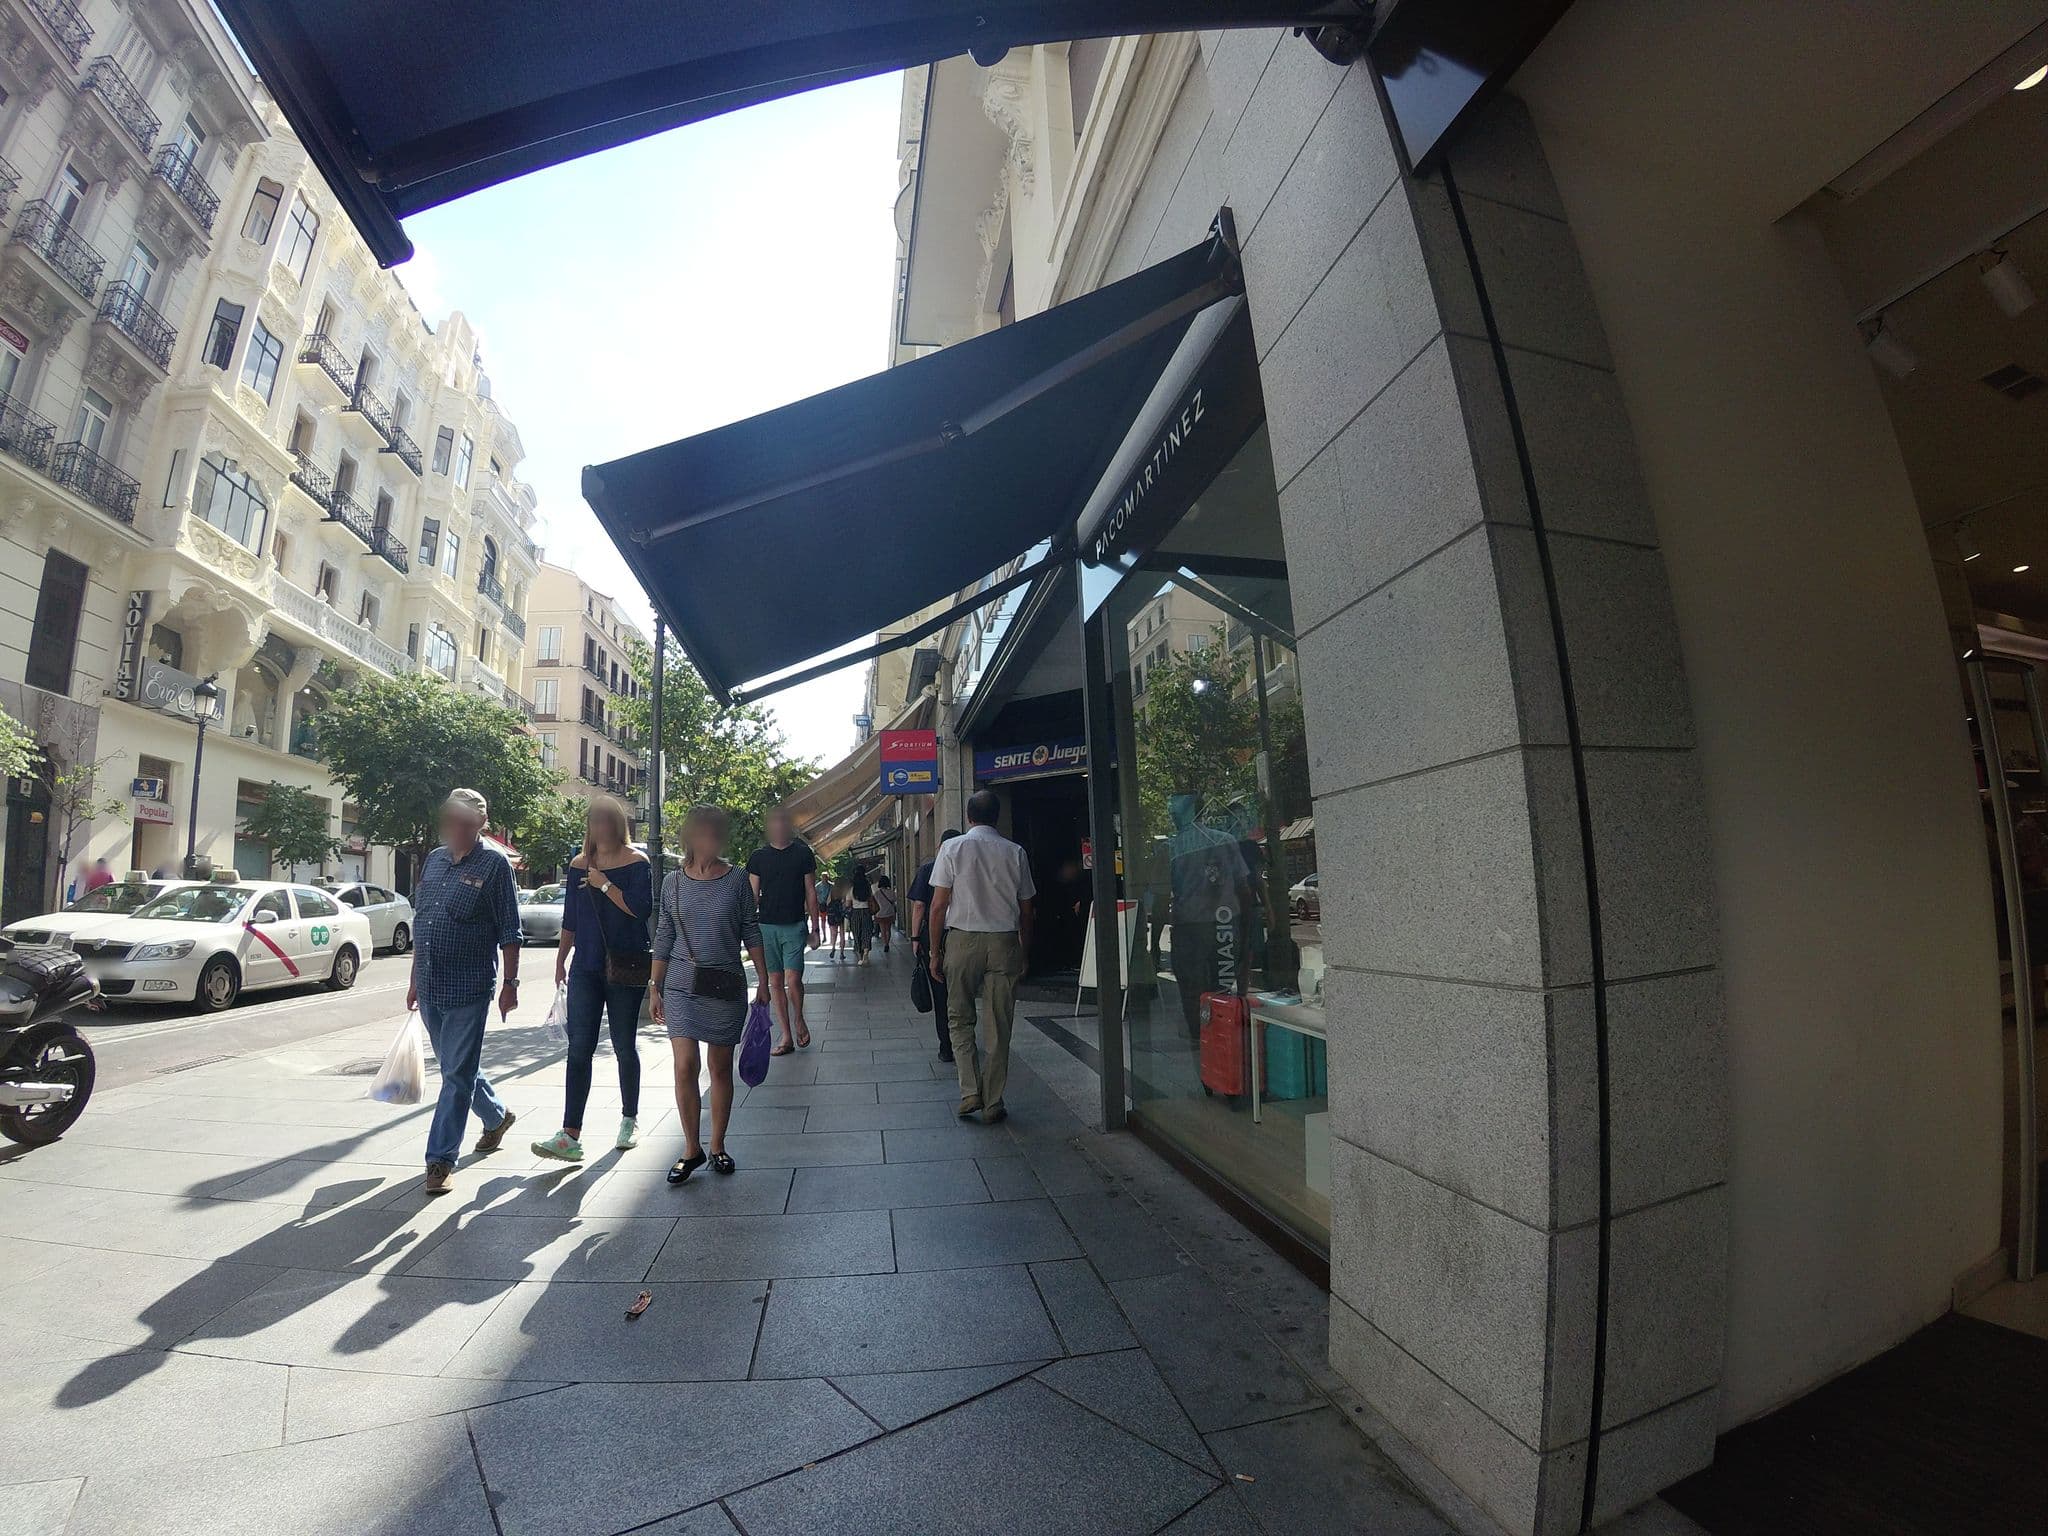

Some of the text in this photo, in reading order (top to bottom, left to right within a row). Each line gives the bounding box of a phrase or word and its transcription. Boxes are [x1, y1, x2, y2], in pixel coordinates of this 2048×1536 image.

[116, 591, 144, 699] NOVIAS
[994, 751, 1032, 769] SENTE
[139, 804, 169, 818] Popular
